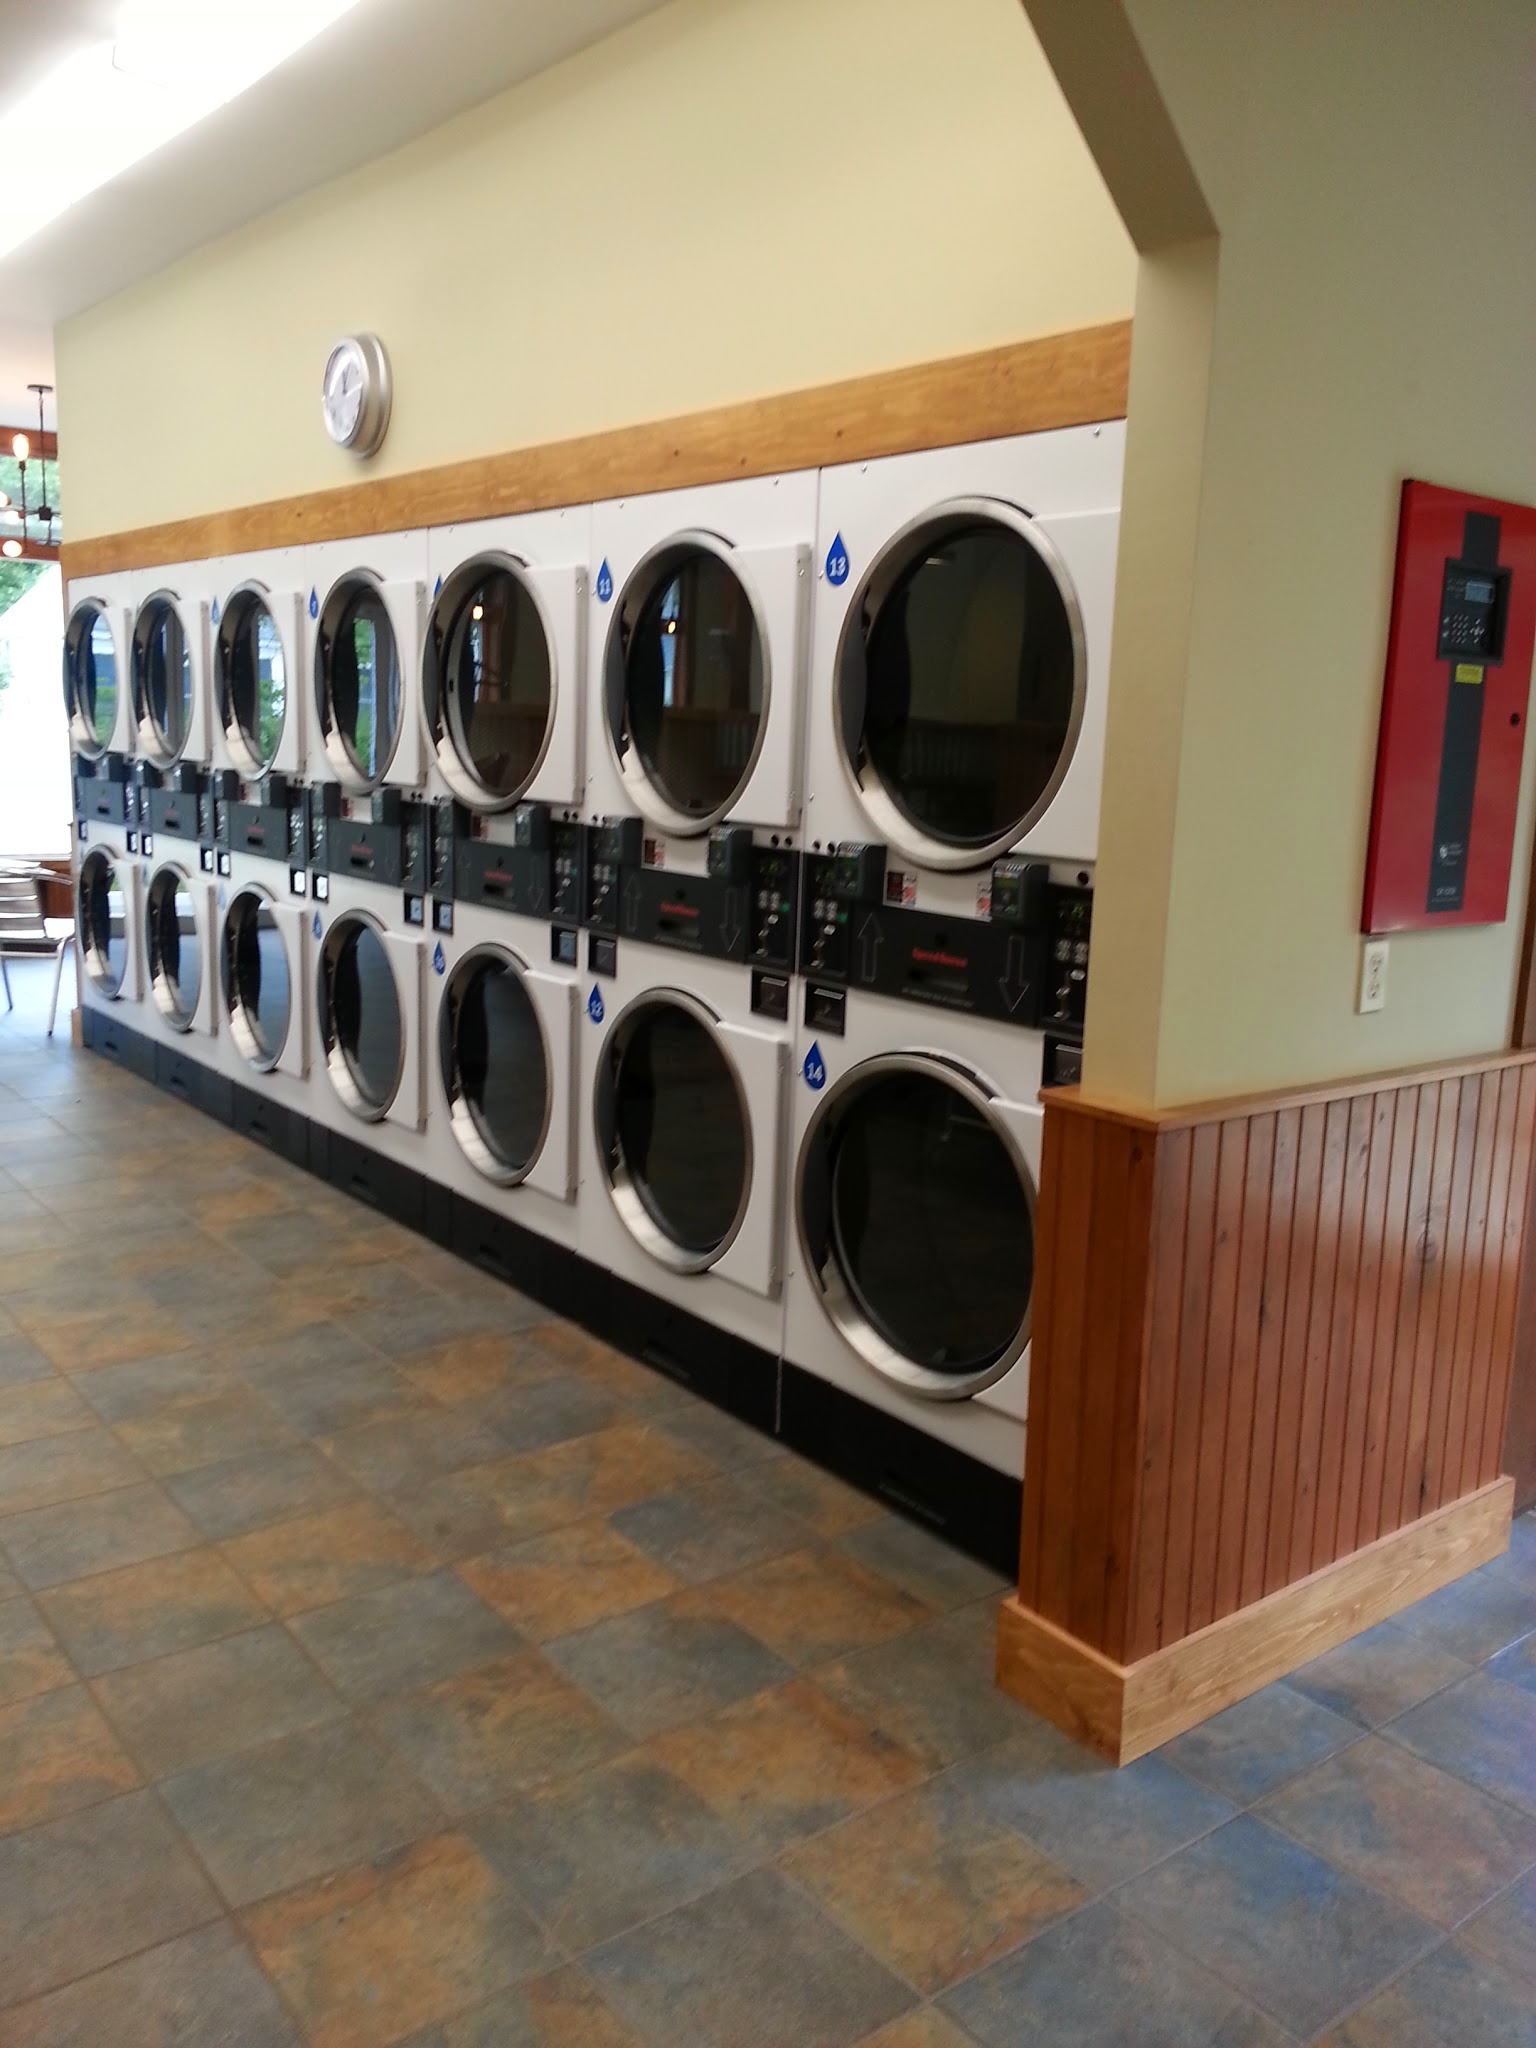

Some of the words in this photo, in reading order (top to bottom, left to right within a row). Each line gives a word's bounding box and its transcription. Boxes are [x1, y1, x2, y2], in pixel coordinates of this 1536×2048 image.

[829, 556, 847, 577] 13
[598, 577, 612, 596] 11
[590, 1000, 603, 1017] 12
[806, 1061, 824, 1083] 14
